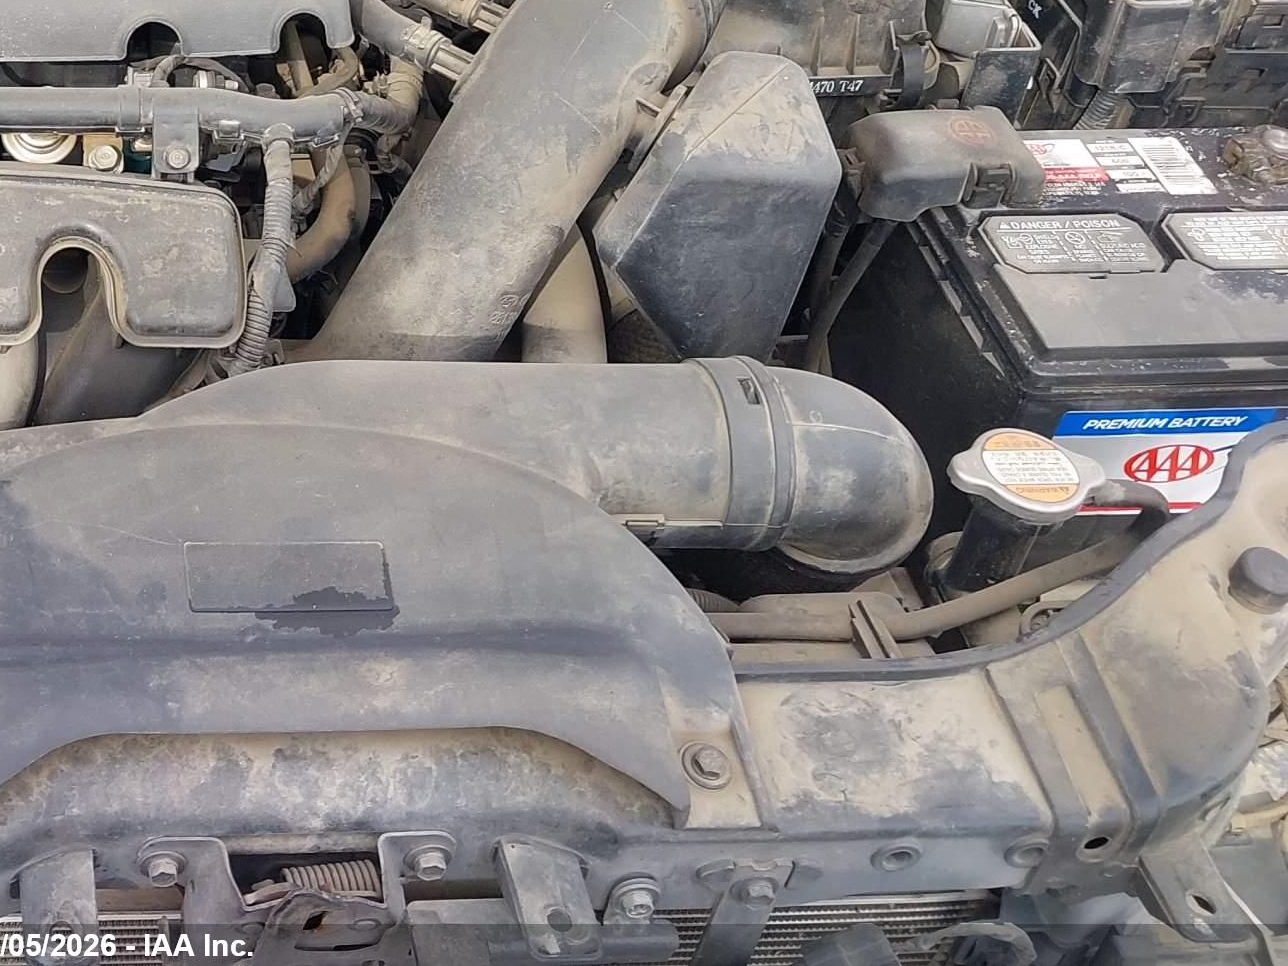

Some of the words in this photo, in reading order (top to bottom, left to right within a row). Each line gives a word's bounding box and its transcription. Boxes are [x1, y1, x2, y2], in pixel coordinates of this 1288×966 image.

[1009, 219, 1061, 229] DANGER
[1072, 218, 1121, 228] POISON
[1082, 417, 1168, 430] PREMIUM
[1170, 415, 1248, 428] BATTERY
[1128, 445, 1209, 482] AAA
